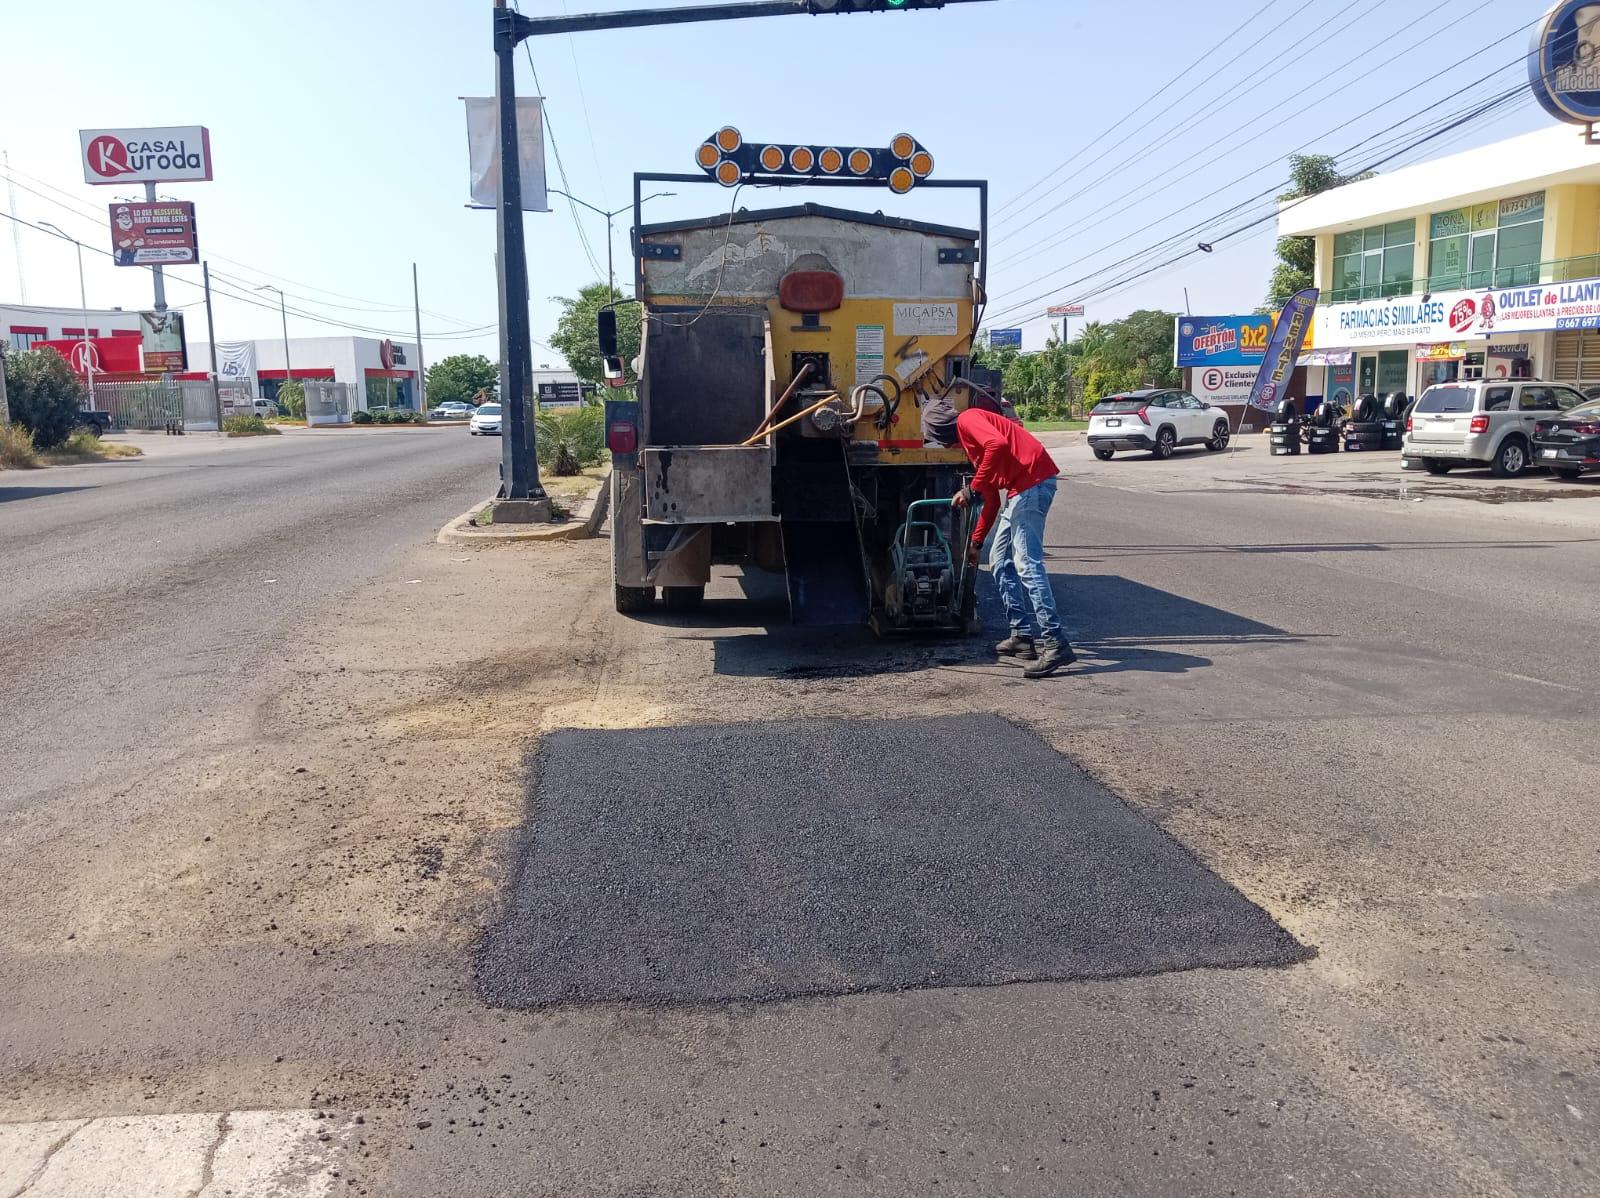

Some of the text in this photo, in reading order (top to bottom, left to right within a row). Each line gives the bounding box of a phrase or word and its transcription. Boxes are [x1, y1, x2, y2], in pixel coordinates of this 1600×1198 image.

[126, 141, 178, 154] CASA
[1437, 213, 1465, 229] ZONA
[1500, 288, 1543, 309] OUTLET
[1544, 291, 1558, 305] de
[896, 306, 954, 318] MICAPSA
[1340, 306, 1390, 330] FARMACIAS
[1391, 302, 1444, 326] SIMILARES
[1452, 306, 1473, 325] 75%
[1511, 309, 1533, 320] MEJORES
[1561, 305, 1584, 315] PRECIOS
[1585, 304, 1593, 314] DE
[1406, 326, 1431, 335] BARATO
[1565, 316, 1597, 329] 667 697
[1240, 325, 1268, 347] 3x2
[1271, 312, 1304, 383] REMATE
[1492, 343, 1529, 353] SERVICIO
[1208, 374, 1218, 386] E
